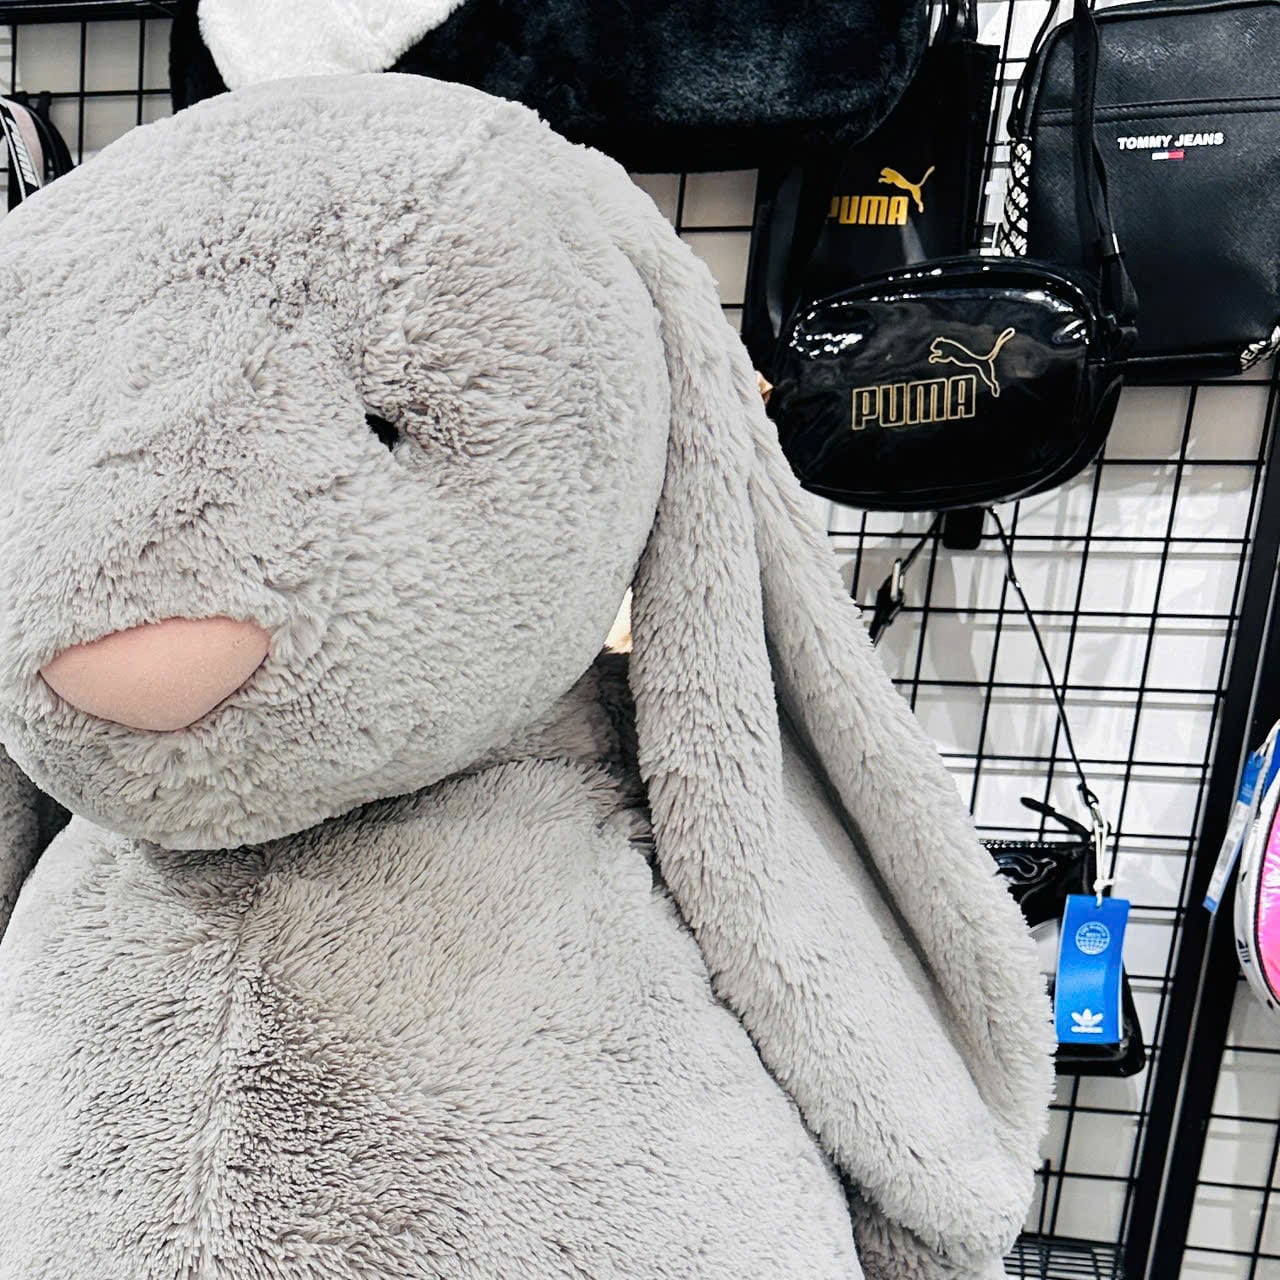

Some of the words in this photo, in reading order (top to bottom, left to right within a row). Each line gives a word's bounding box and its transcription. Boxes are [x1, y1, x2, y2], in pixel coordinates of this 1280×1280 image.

[1117, 134, 1173, 150] TOMMY
[1174, 132, 1224, 147] JEANS
[852, 375, 977, 431] PUMA
